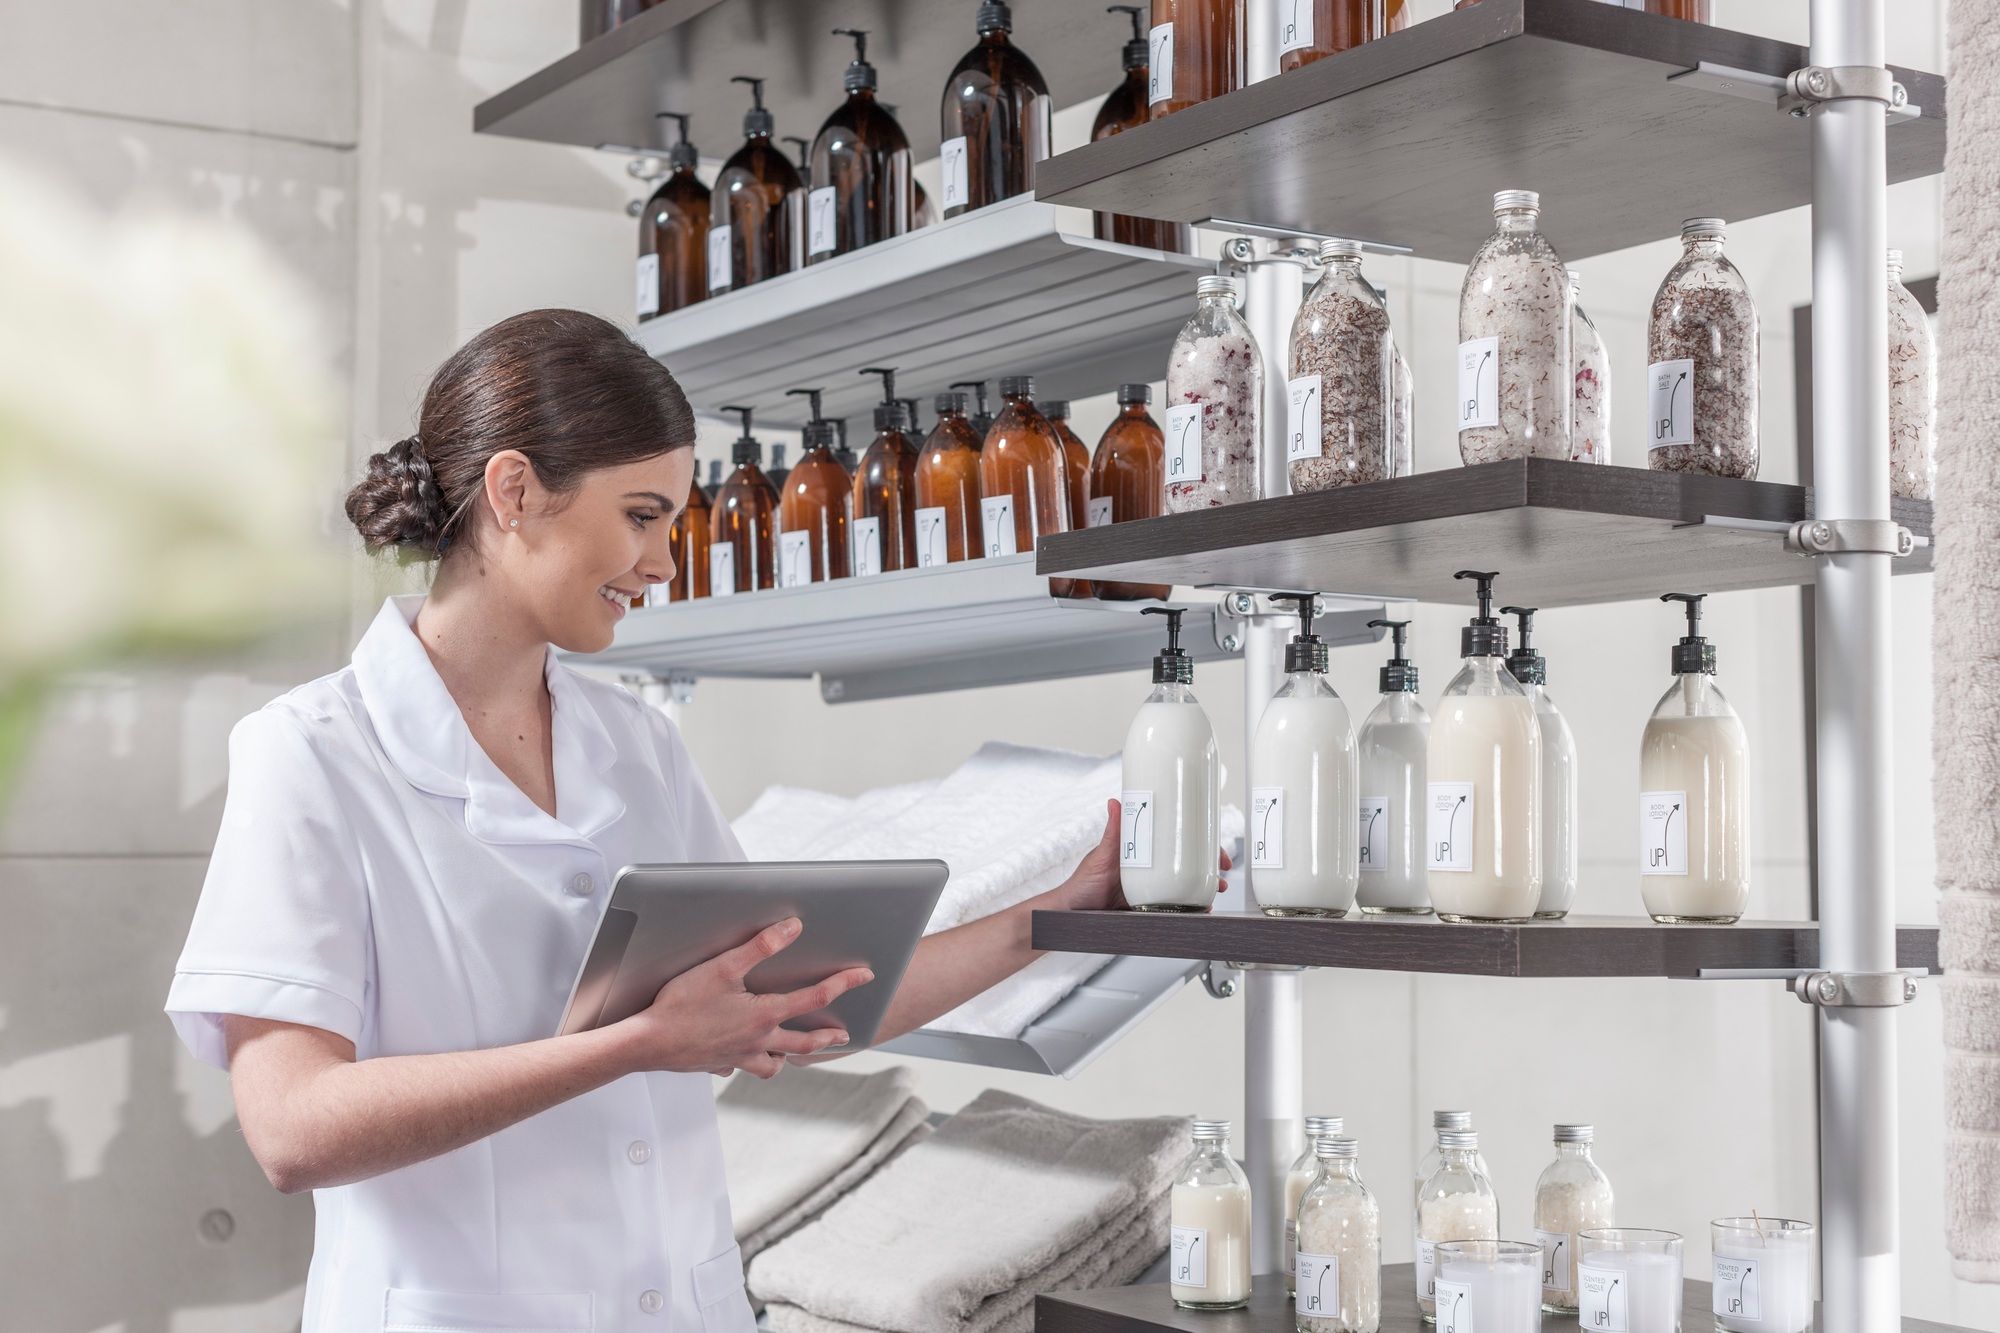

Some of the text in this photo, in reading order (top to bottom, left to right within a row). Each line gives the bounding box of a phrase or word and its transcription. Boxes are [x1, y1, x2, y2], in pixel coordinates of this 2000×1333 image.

[1657, 374, 1670, 382] BATH
[1463, 399, 1476, 420] UP
[1655, 418, 1671, 439] UP
[1170, 457, 1182, 475] UP
[1124, 841, 1135, 859] UP
[1435, 841, 1450, 861] UP
[1650, 848, 1665, 867] UP
[1178, 1266, 1189, 1280] UP
[1301, 1261, 1312, 1269] BATH
[1301, 1268, 1312, 1276] SALT
[1306, 1295, 1319, 1310] UP
[1728, 1298, 1741, 1313] UP
[1594, 1310, 1607, 1326] UP
